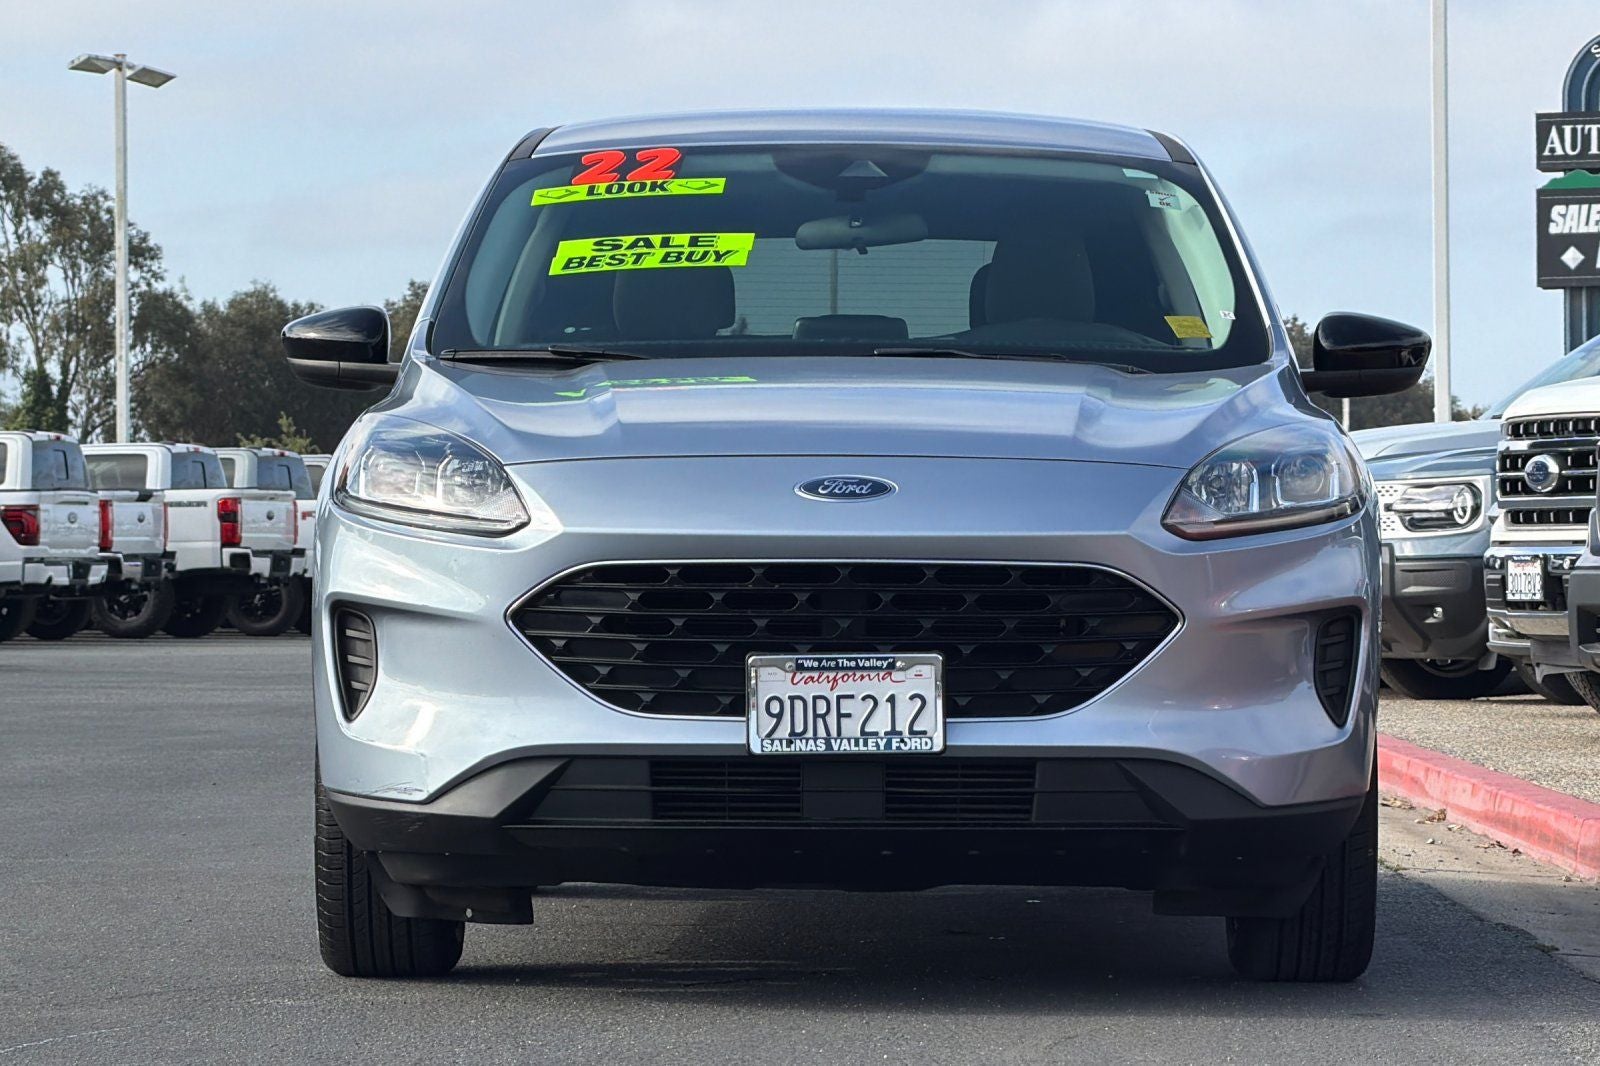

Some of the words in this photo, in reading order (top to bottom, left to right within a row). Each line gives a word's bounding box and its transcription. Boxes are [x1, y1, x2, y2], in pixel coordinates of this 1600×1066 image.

[1542, 123, 1600, 156] AUT
[571, 147, 682, 185] 22
[585, 180, 675, 198] LOOK
[1548, 204, 1600, 234] SALE
[591, 234, 720, 252] SALE
[560, 251, 654, 272] BEST
[658, 249, 739, 265] BUY
[818, 478, 873, 494] Ford
[820, 659, 836, 667] Are
[837, 659, 856, 667] The
[790, 671, 906, 692] California
[763, 693, 928, 738] 9DRF212
[762, 738, 826, 751] SALINAS
[830, 738, 887, 751] VALLEY
[892, 738, 932, 751] FORD
